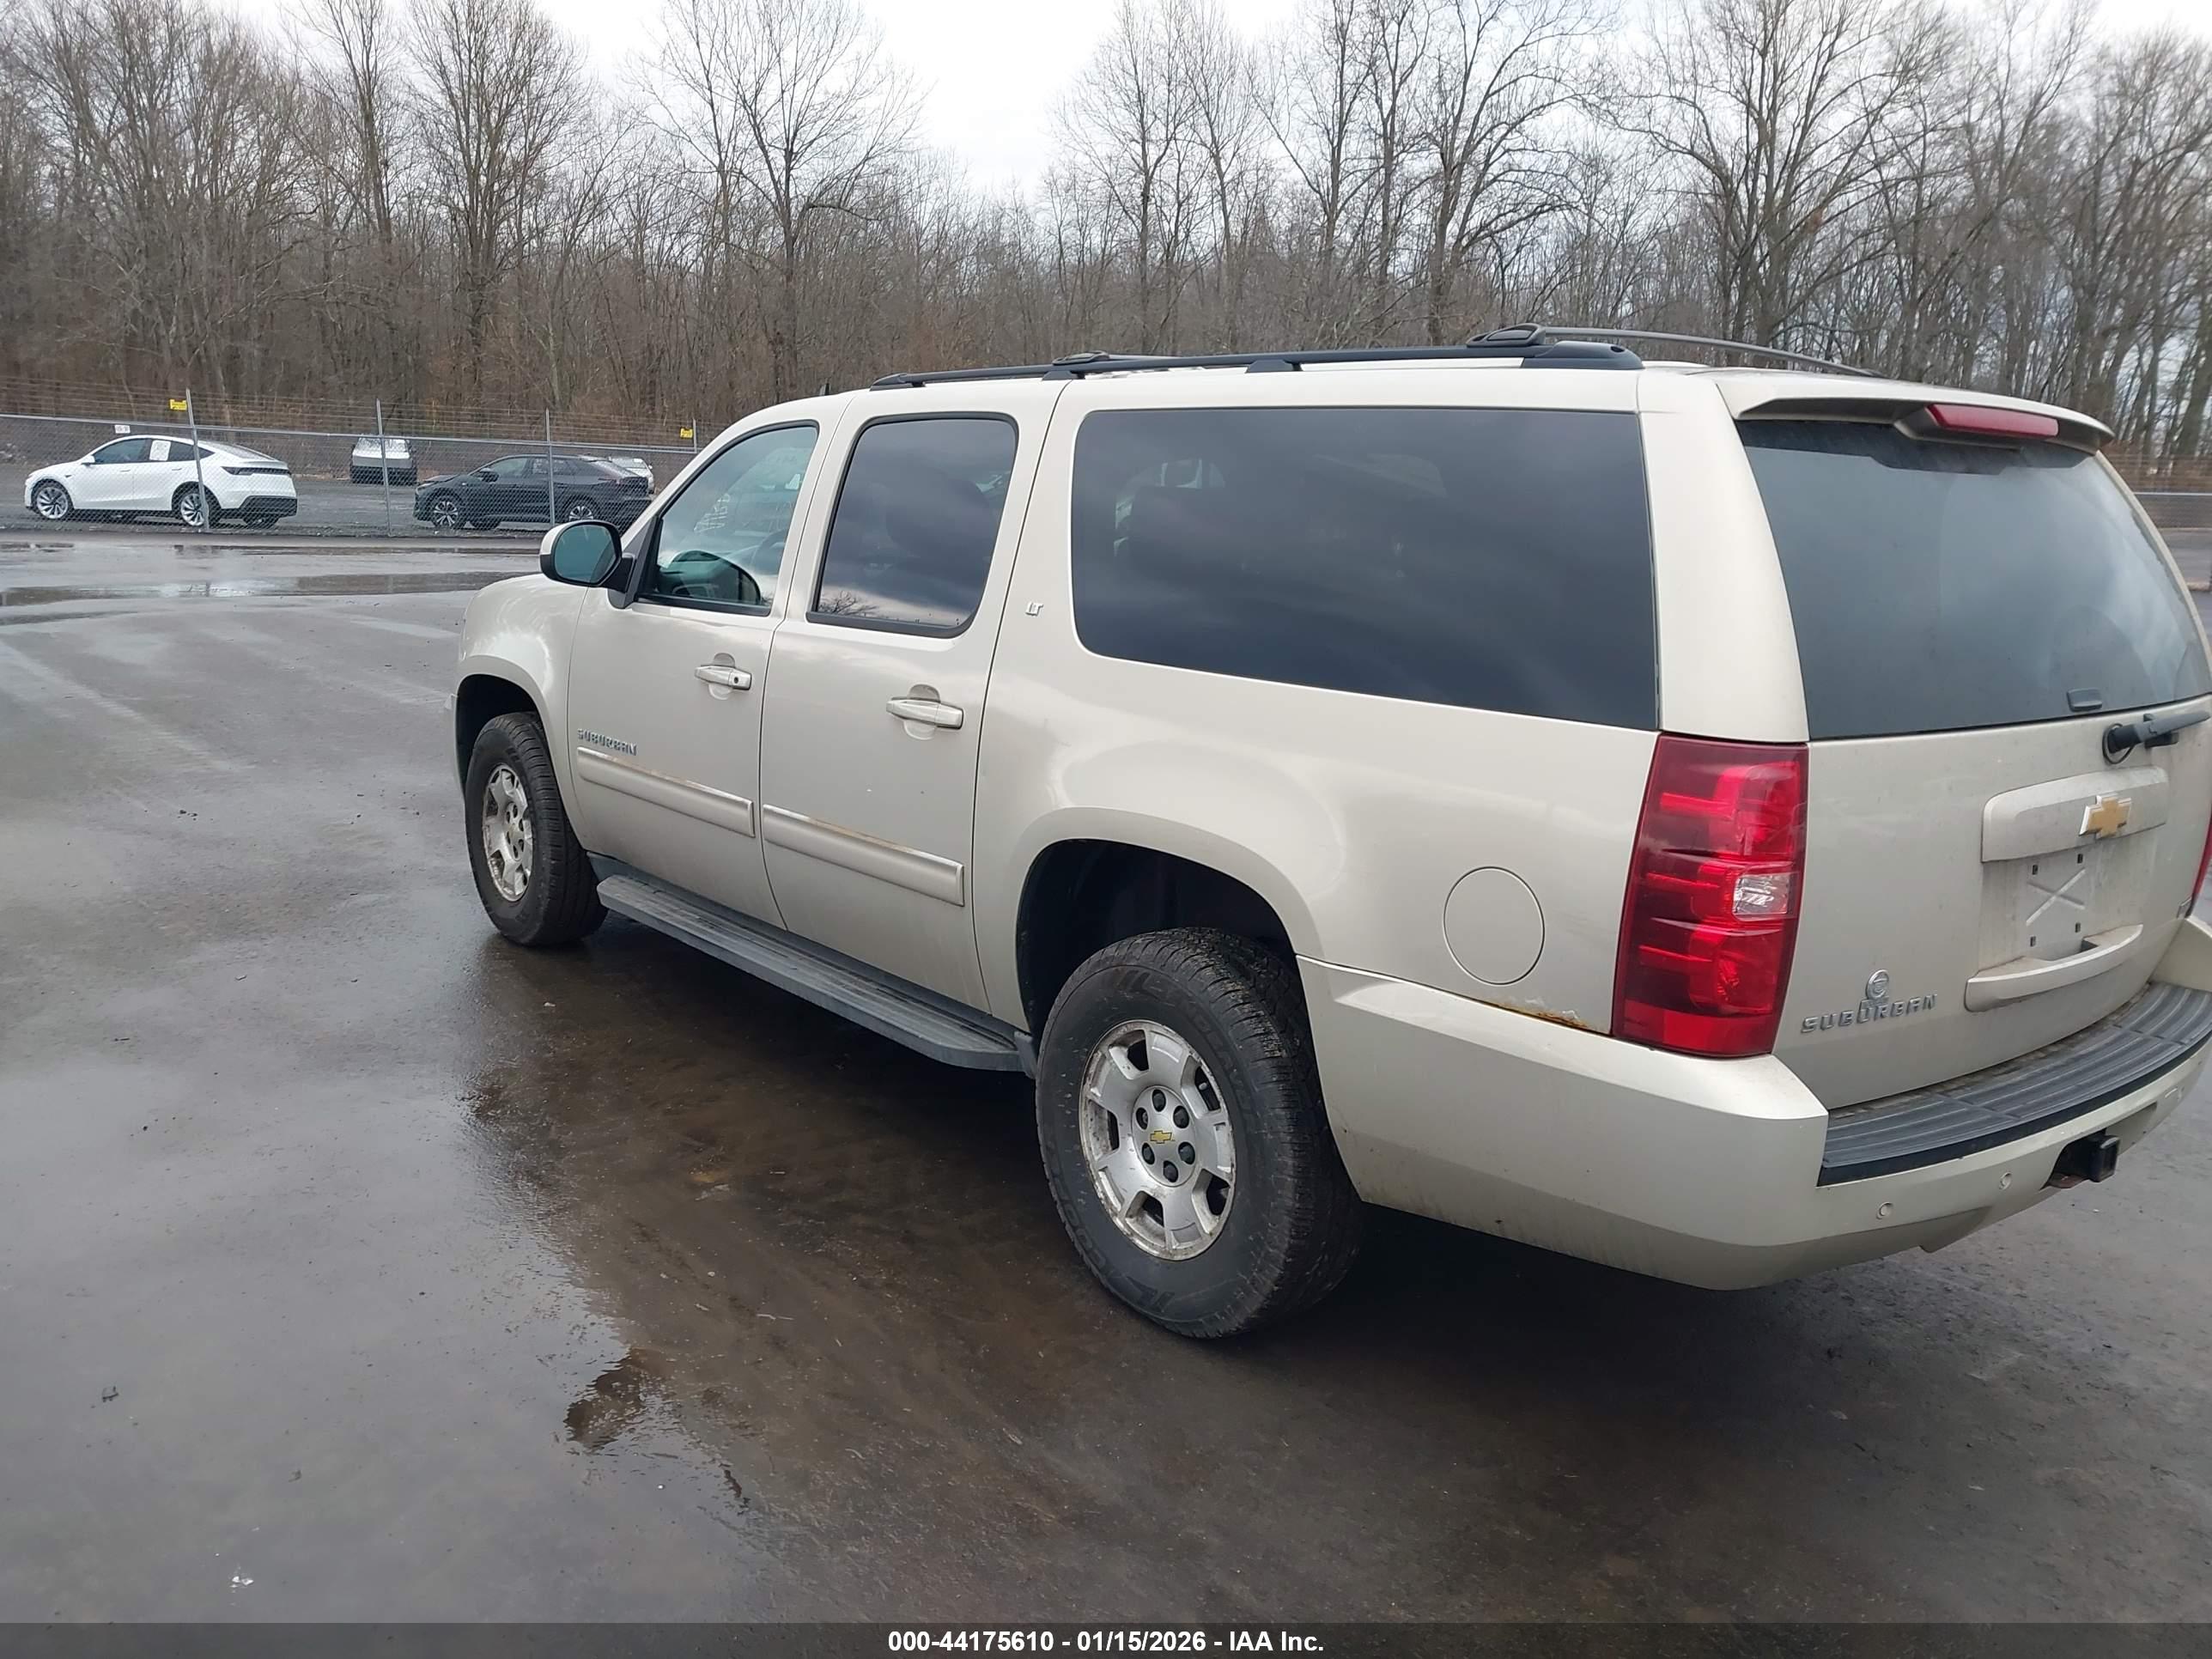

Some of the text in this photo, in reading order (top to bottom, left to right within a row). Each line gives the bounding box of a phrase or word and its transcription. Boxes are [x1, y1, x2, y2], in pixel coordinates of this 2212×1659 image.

[1024, 602, 1044, 617] LT
[577, 728, 637, 756] SUBURBAN
[1801, 994, 1937, 1034] SUBURBAN
